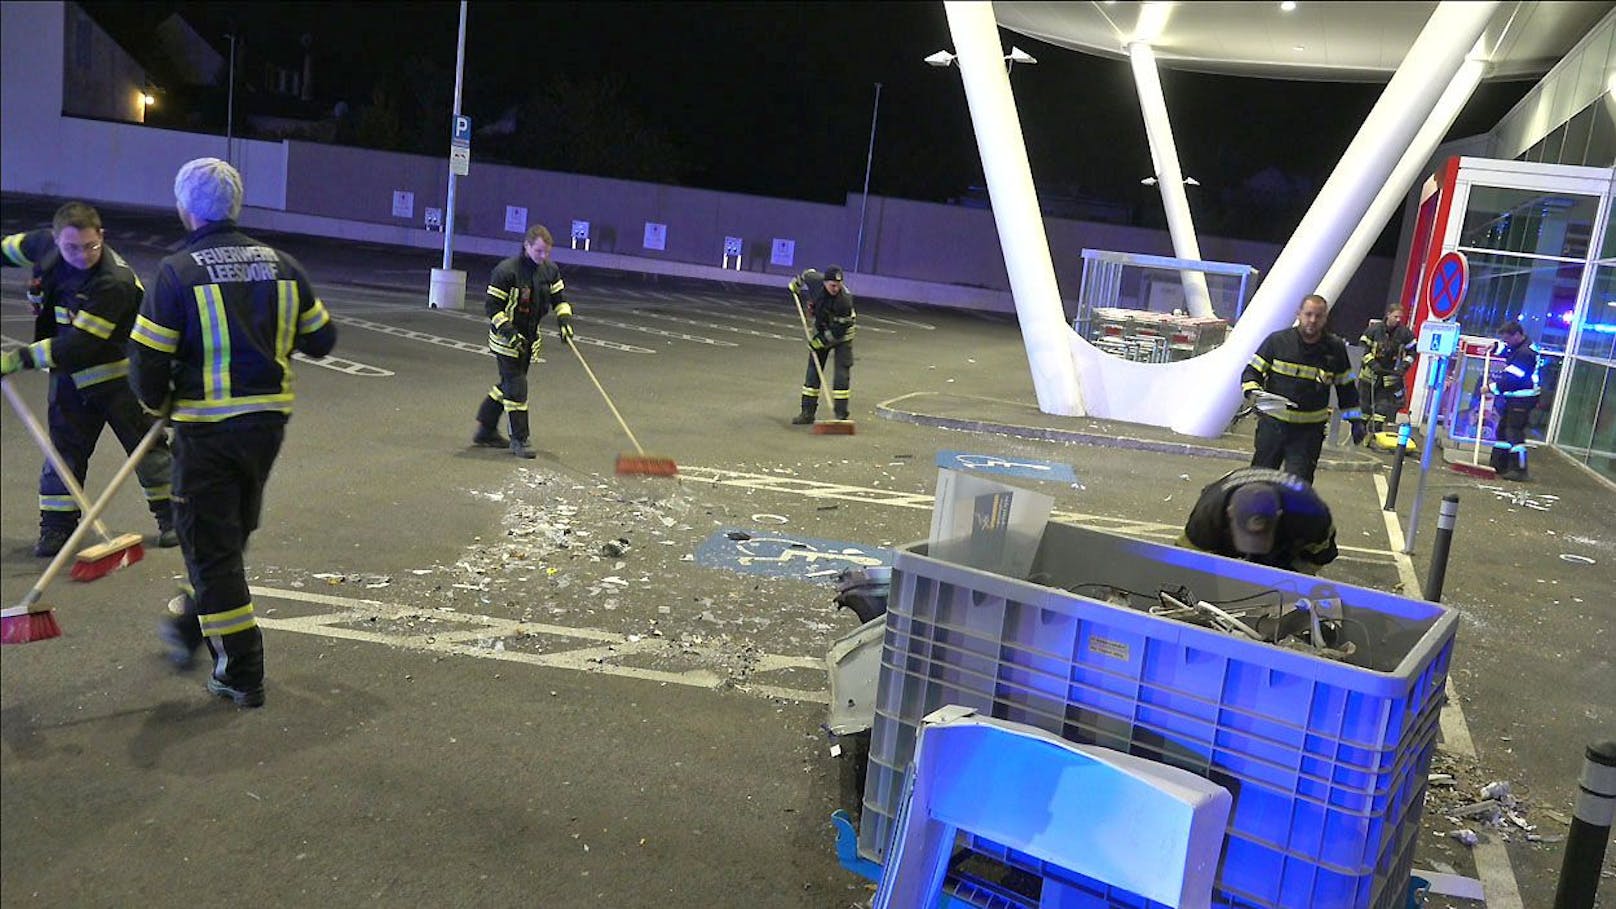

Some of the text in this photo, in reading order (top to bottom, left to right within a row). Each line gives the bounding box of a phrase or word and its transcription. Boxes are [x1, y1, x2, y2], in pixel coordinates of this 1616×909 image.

[456, 117, 468, 137] P
[190, 246, 280, 266] FEUERWEHR
[206, 262, 279, 283] LEESDORF
